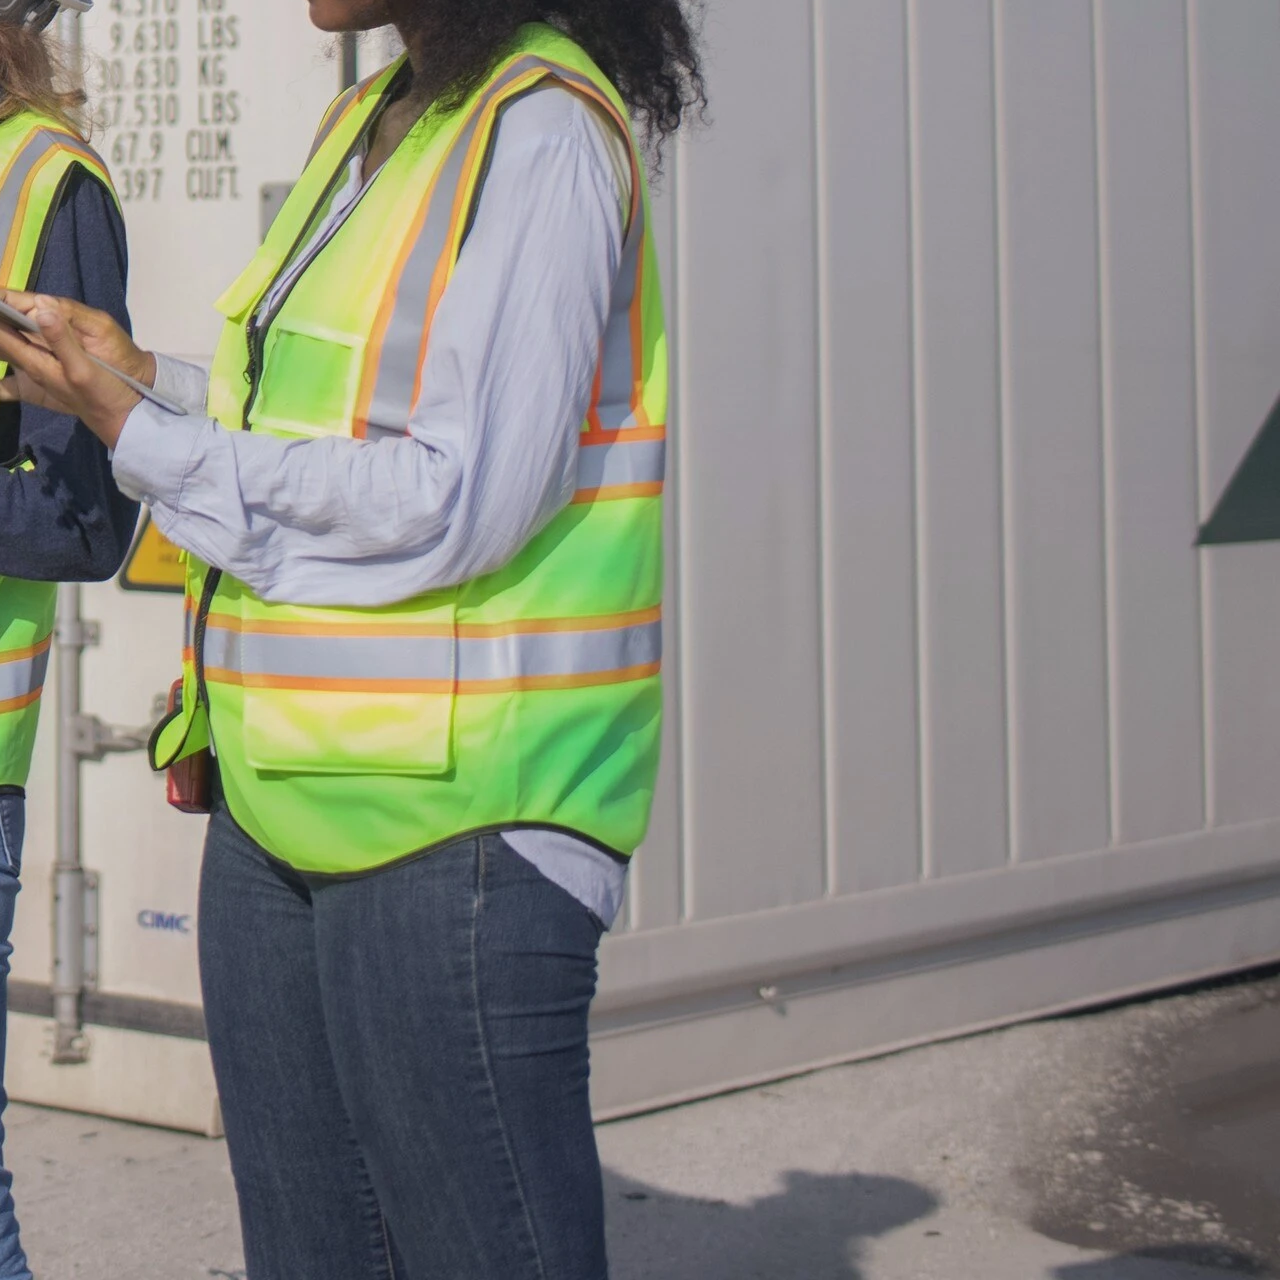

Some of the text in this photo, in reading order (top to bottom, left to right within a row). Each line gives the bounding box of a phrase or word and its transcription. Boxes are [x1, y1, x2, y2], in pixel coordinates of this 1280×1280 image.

[109, 15, 240, 53] 9.630 LBS
[198, 54, 227, 87] KG
[198, 90, 241, 126] LBS
[111, 130, 164, 166] 67.9
[137, 908, 192, 934] CIMC
